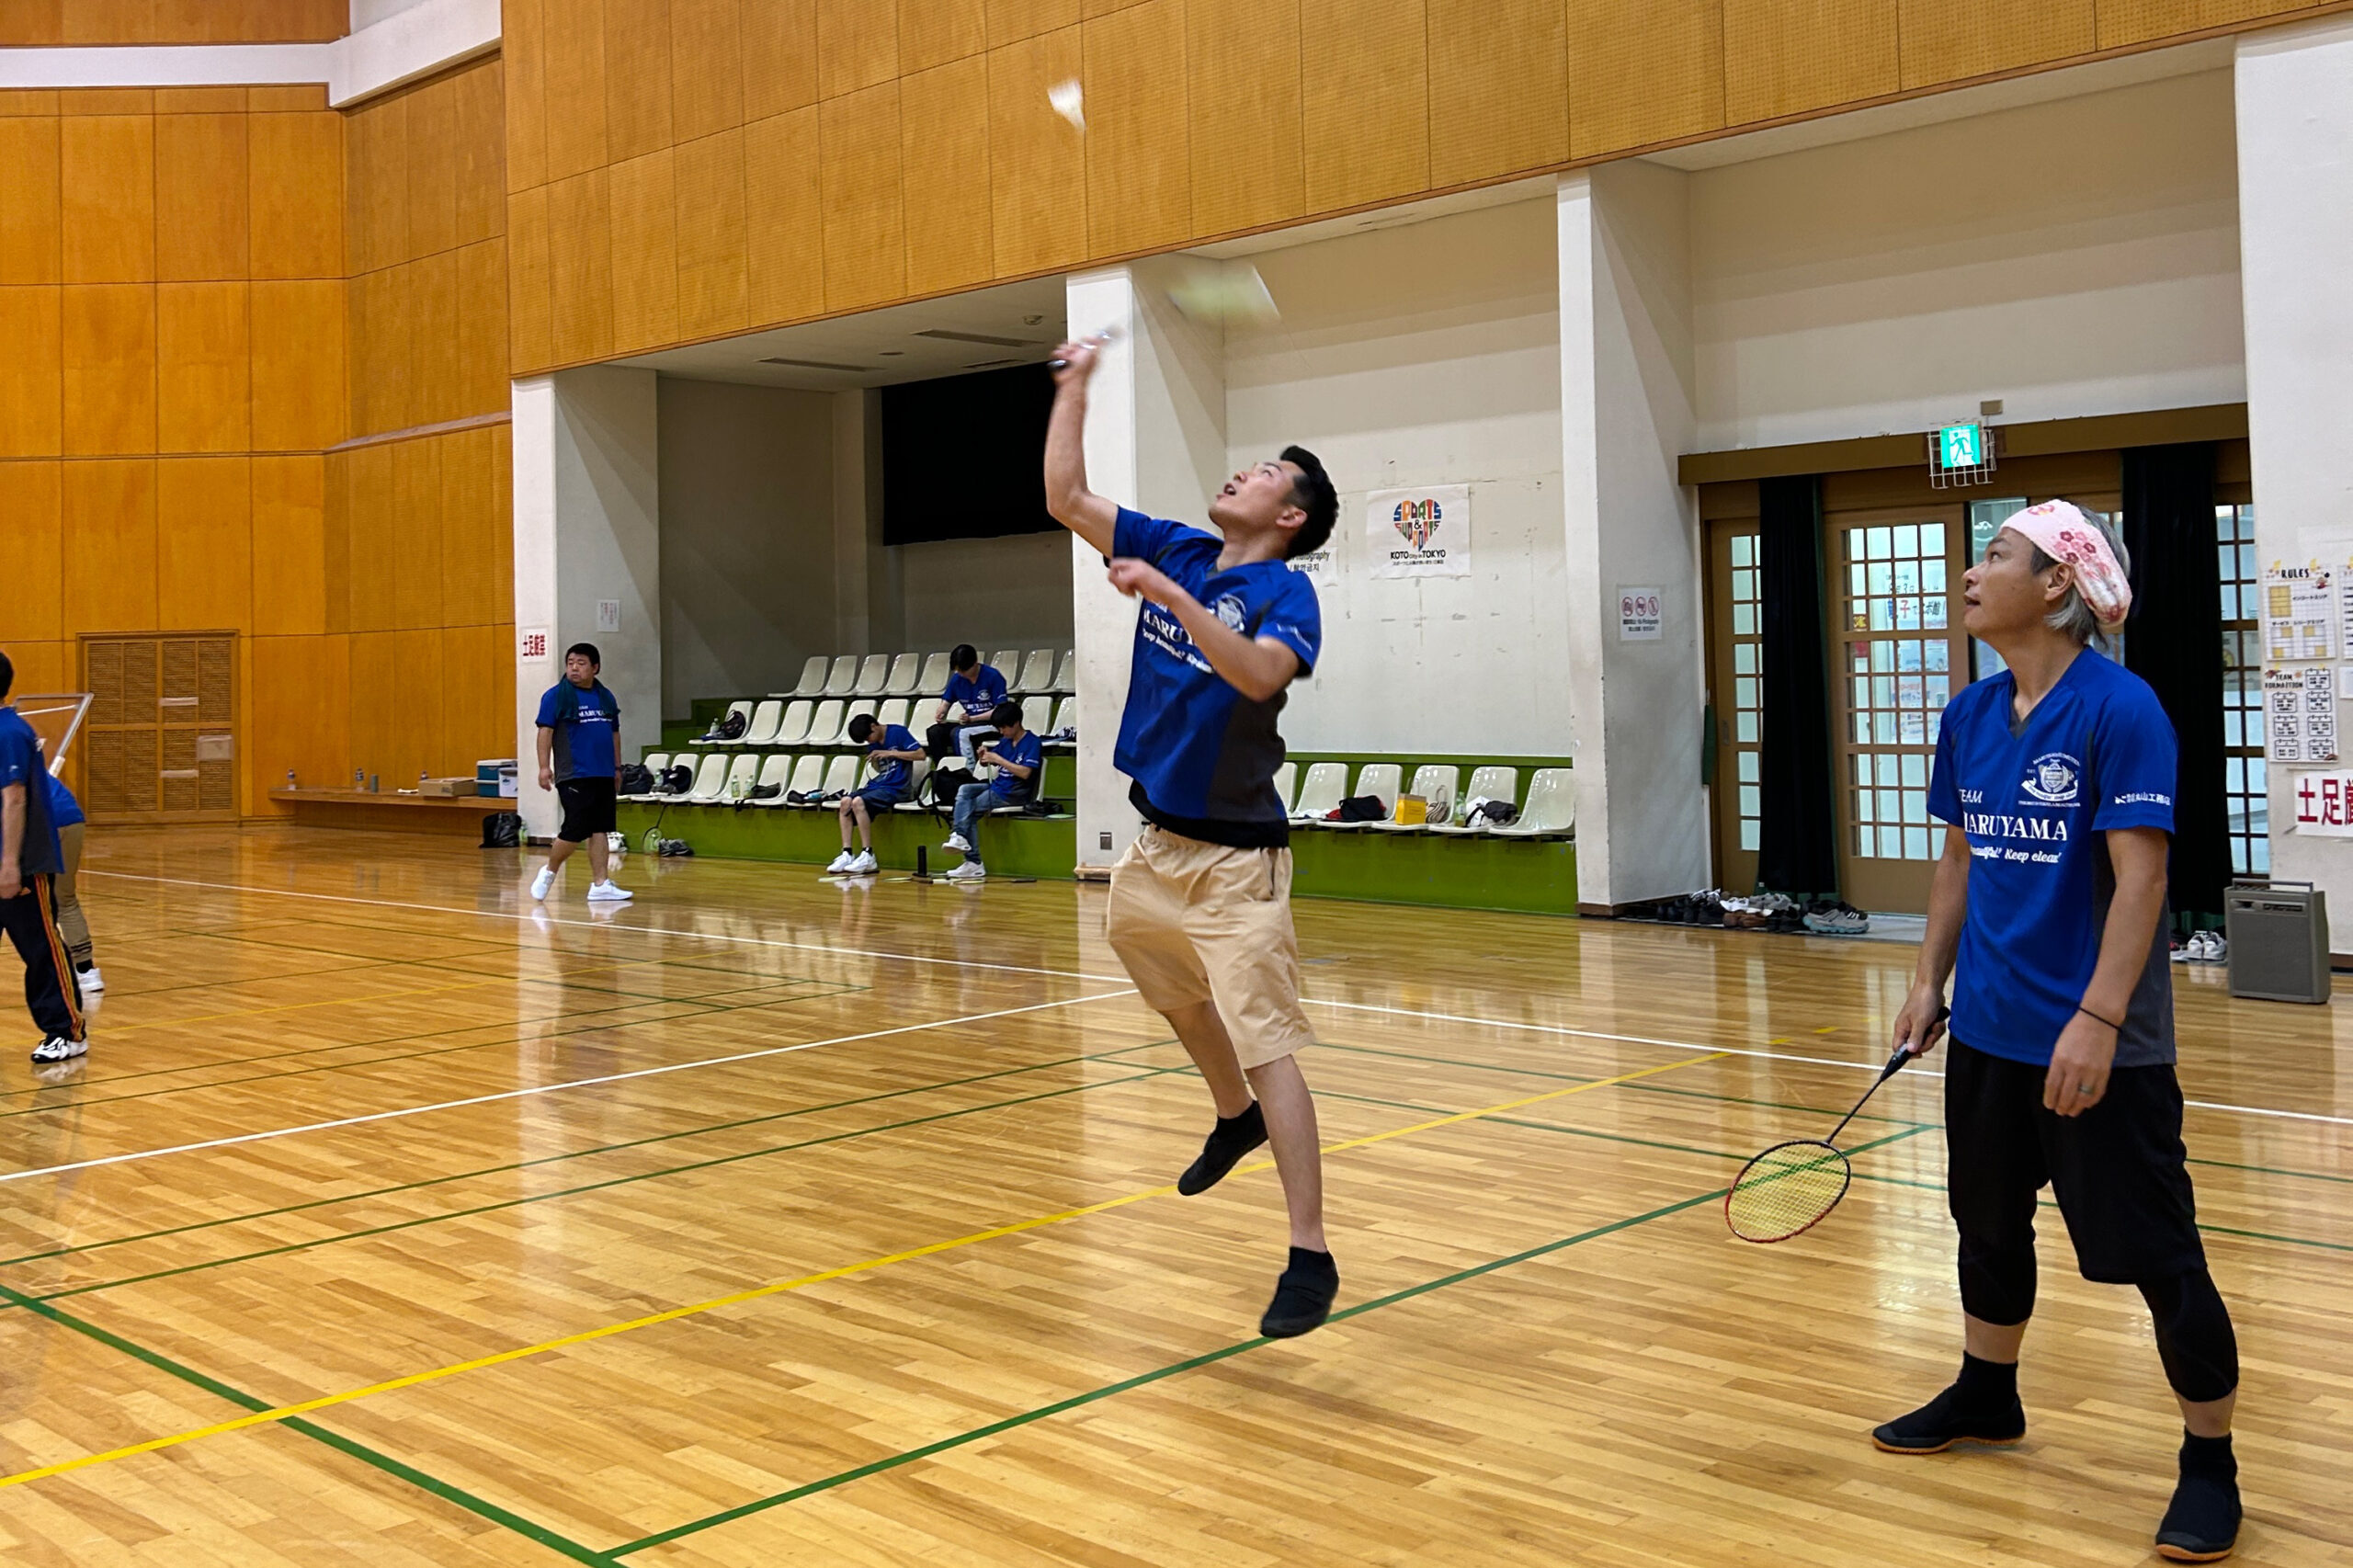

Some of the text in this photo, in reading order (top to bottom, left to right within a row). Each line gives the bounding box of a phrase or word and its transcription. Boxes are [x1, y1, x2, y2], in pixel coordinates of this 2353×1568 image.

[1393, 499, 1442, 522] SPORTS
[1390, 551, 1409, 560] KOTO
[1422, 550, 1447, 558] TOKYO
[2280, 568, 2310, 579] RULES
[2005, 848, 2029, 864] Keep
